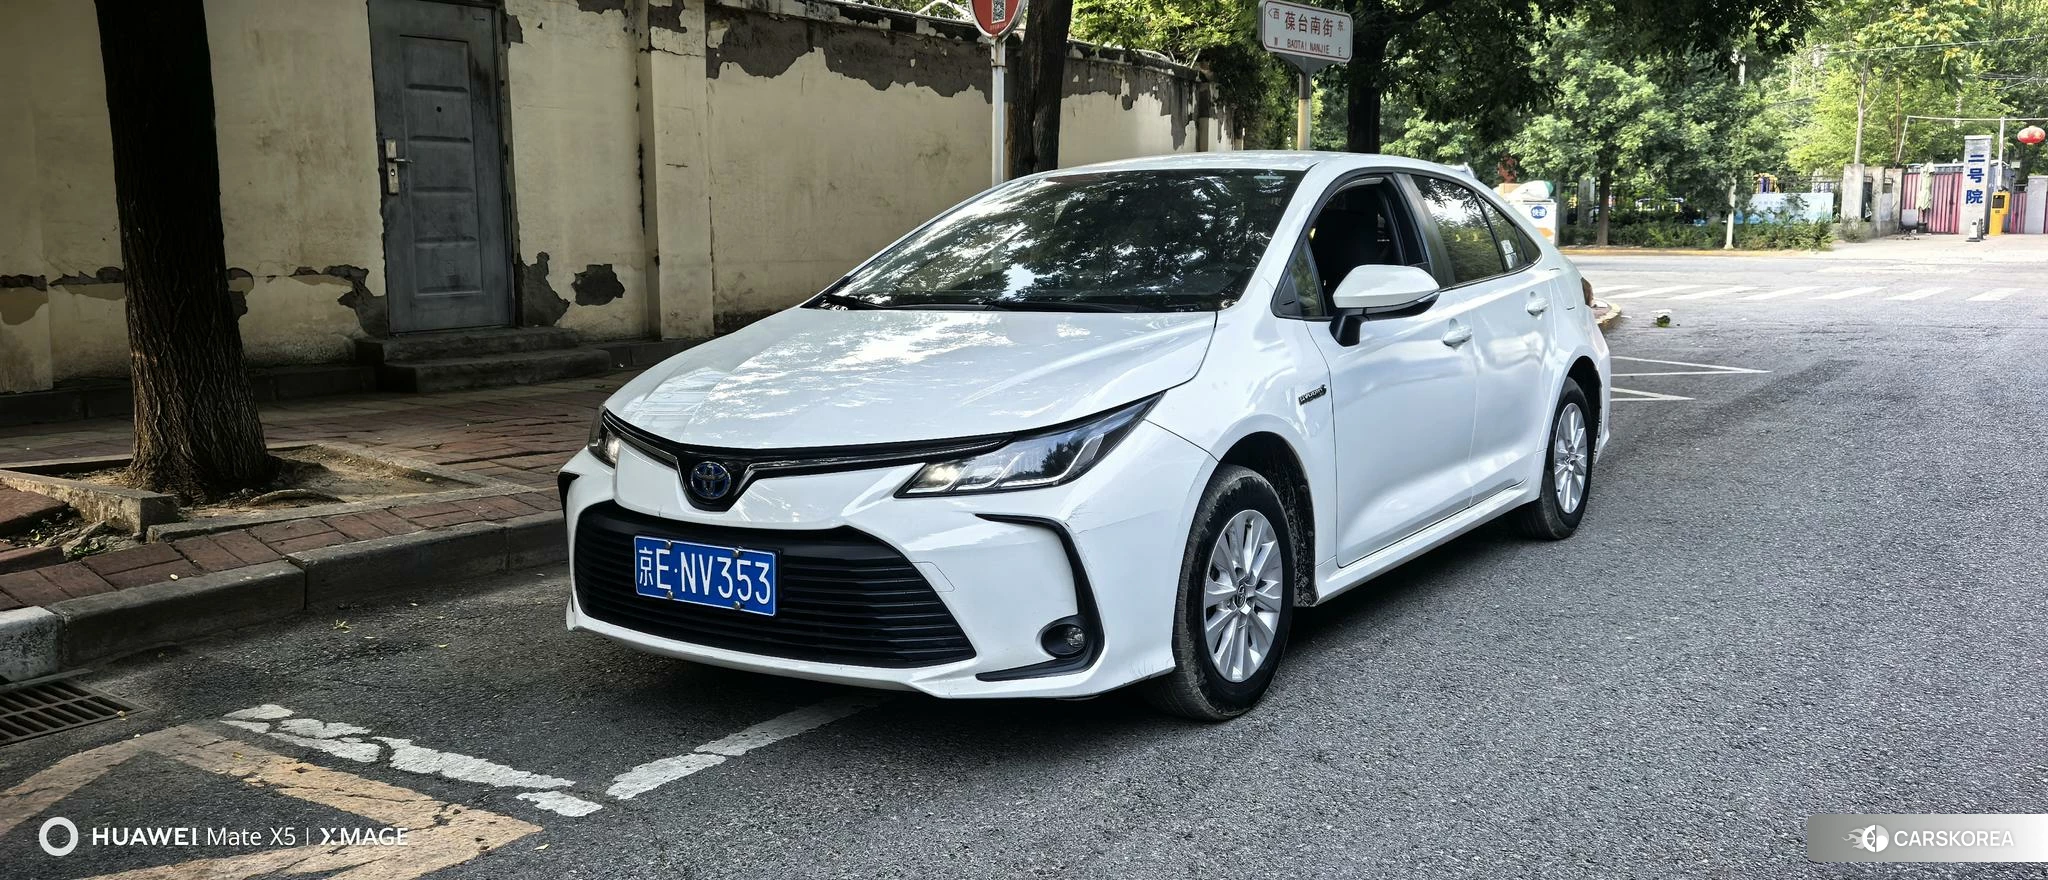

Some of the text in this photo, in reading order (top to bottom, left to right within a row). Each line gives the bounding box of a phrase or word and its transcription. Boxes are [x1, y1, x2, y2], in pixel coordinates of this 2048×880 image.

[1285, 11, 1333, 38] 葆台南街
[1287, 38, 1307, 50] BAOTAI
[1310, 42, 1330, 54] NANJIE
[1965, 154, 1985, 205] 二号院
